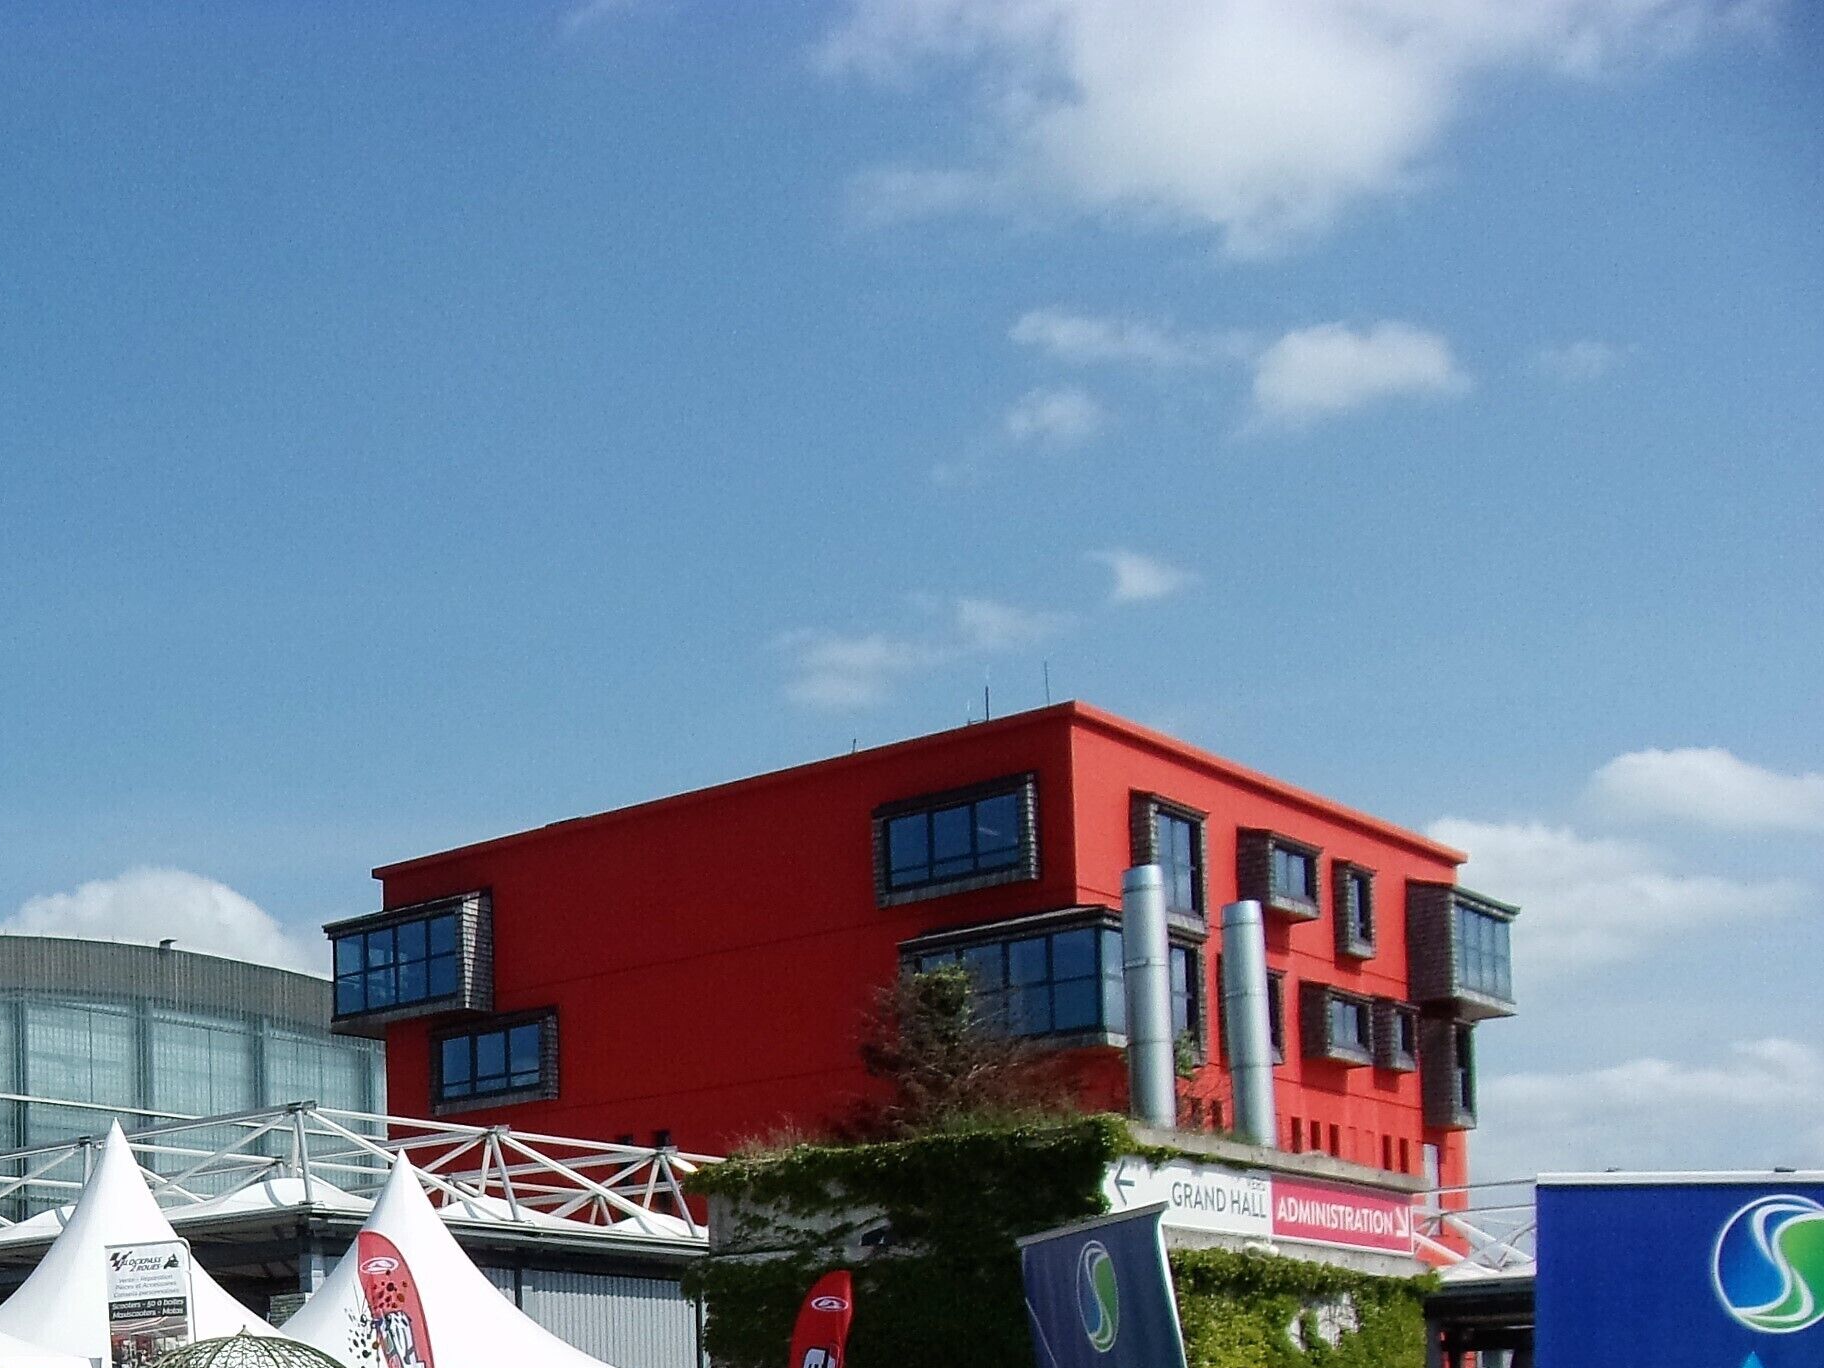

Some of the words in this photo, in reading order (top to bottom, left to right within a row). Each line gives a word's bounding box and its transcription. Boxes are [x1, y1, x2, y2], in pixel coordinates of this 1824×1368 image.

[1171, 1181, 1227, 1213] GRAND
[1231, 1192, 1268, 1219] HALL
[1277, 1196, 1394, 1236] ADMINISTRATION
